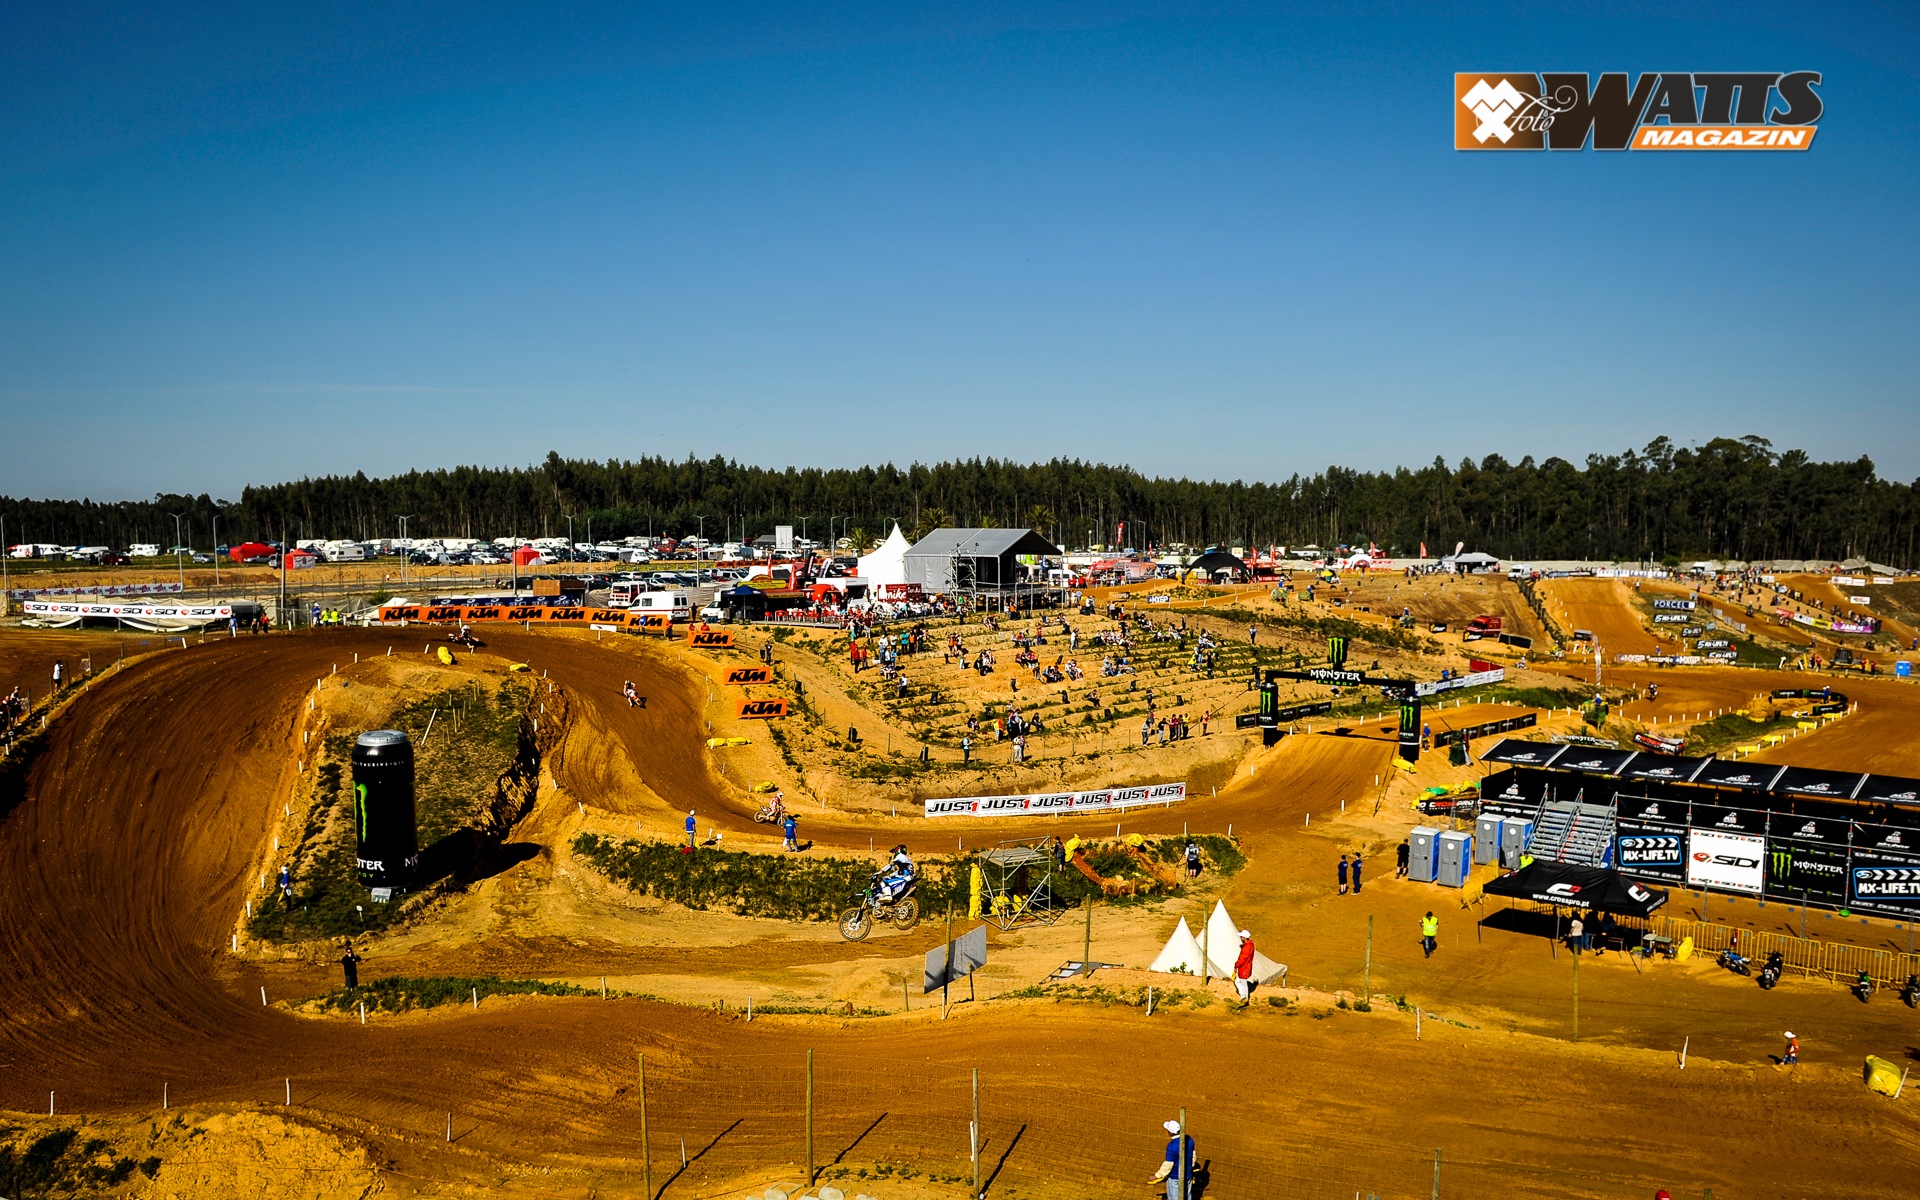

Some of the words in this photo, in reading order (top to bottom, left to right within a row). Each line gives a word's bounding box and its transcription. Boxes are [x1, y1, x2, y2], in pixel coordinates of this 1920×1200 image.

[1654, 600, 1686, 608] PORCEL
[384, 606, 419, 620] KTM
[427, 607, 461, 620] KTM
[467, 606, 500, 620] KTM
[508, 606, 542, 620] KTM
[550, 608, 586, 620] KTM
[592, 610, 626, 622] KTM
[693, 632, 729, 644] KTM
[729, 668, 766, 682] KTM
[1310, 669, 1361, 682] MONSTER
[741, 701, 783, 715] KTM
[927, 801, 978, 812] JUST1
[982, 798, 1030, 809] JUST1
[1033, 796, 1074, 806] JUST1
[1076, 793, 1112, 804] JUST1
[1114, 790, 1150, 800] JUST1
[1151, 786, 1184, 796] JUST1
[1623, 850, 1679, 860] MX-LIFE.TV
[1712, 854, 1760, 869] SIDI
[1794, 860, 1844, 874] MONSTER
[1532, 894, 1590, 908] www.crosspro.pt
